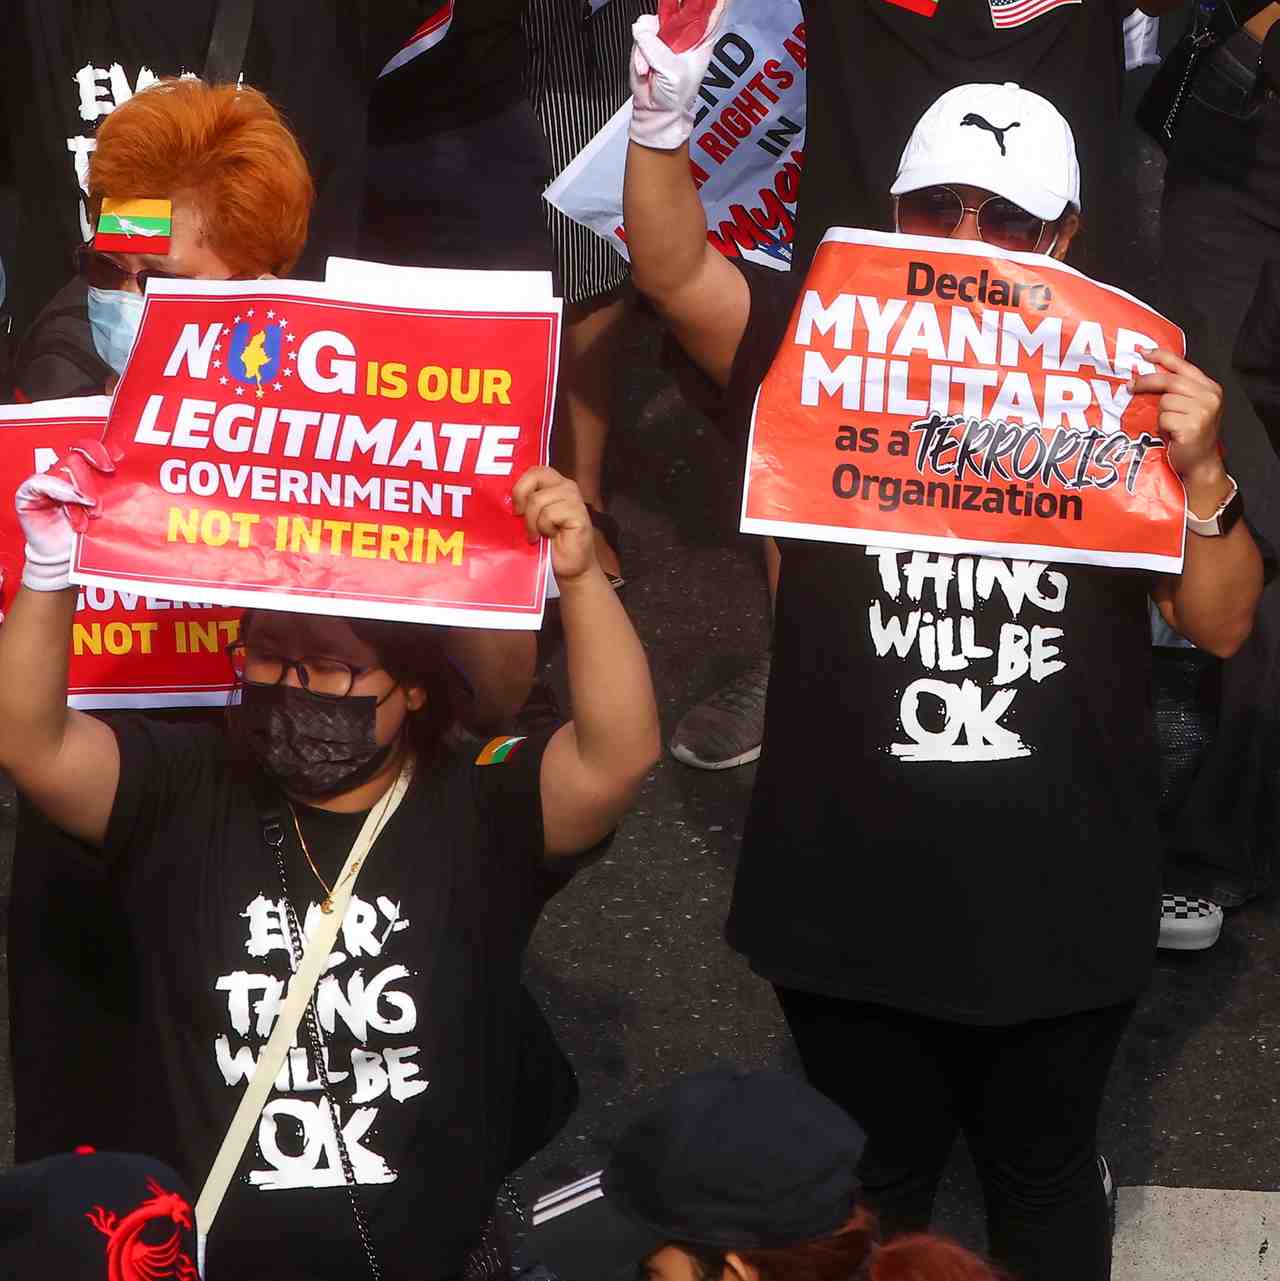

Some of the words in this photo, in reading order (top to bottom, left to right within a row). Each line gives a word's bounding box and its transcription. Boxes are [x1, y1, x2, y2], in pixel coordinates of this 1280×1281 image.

[697, 59, 794, 165] RIGHTS
[757, 115, 802, 158] IN
[906, 262, 1052, 311] Declare
[163, 320, 358, 396] NUG
[366, 361, 404, 400] IS
[417, 365, 513, 405] OUR
[794, 289, 1159, 376] MYANMAR
[800, 351, 1136, 433] MILITARY
[133, 395, 520, 476] LEGITIMATE
[835, 424, 879, 453] as
[888, 430, 909, 457] a
[910, 410, 1165, 493] TERRORIST
[159, 459, 472, 518] GOVERNMENT
[832, 464, 1083, 521] Organization
[167, 508, 261, 550] NOT
[276, 516, 465, 567] INTERIM
[73, 623, 158, 655] NOT
[993, 622, 1068, 686] BE
[890, 678, 1031, 762] OK
[347, 1046, 429, 1103] BE
[248, 1095, 399, 1190] OK
